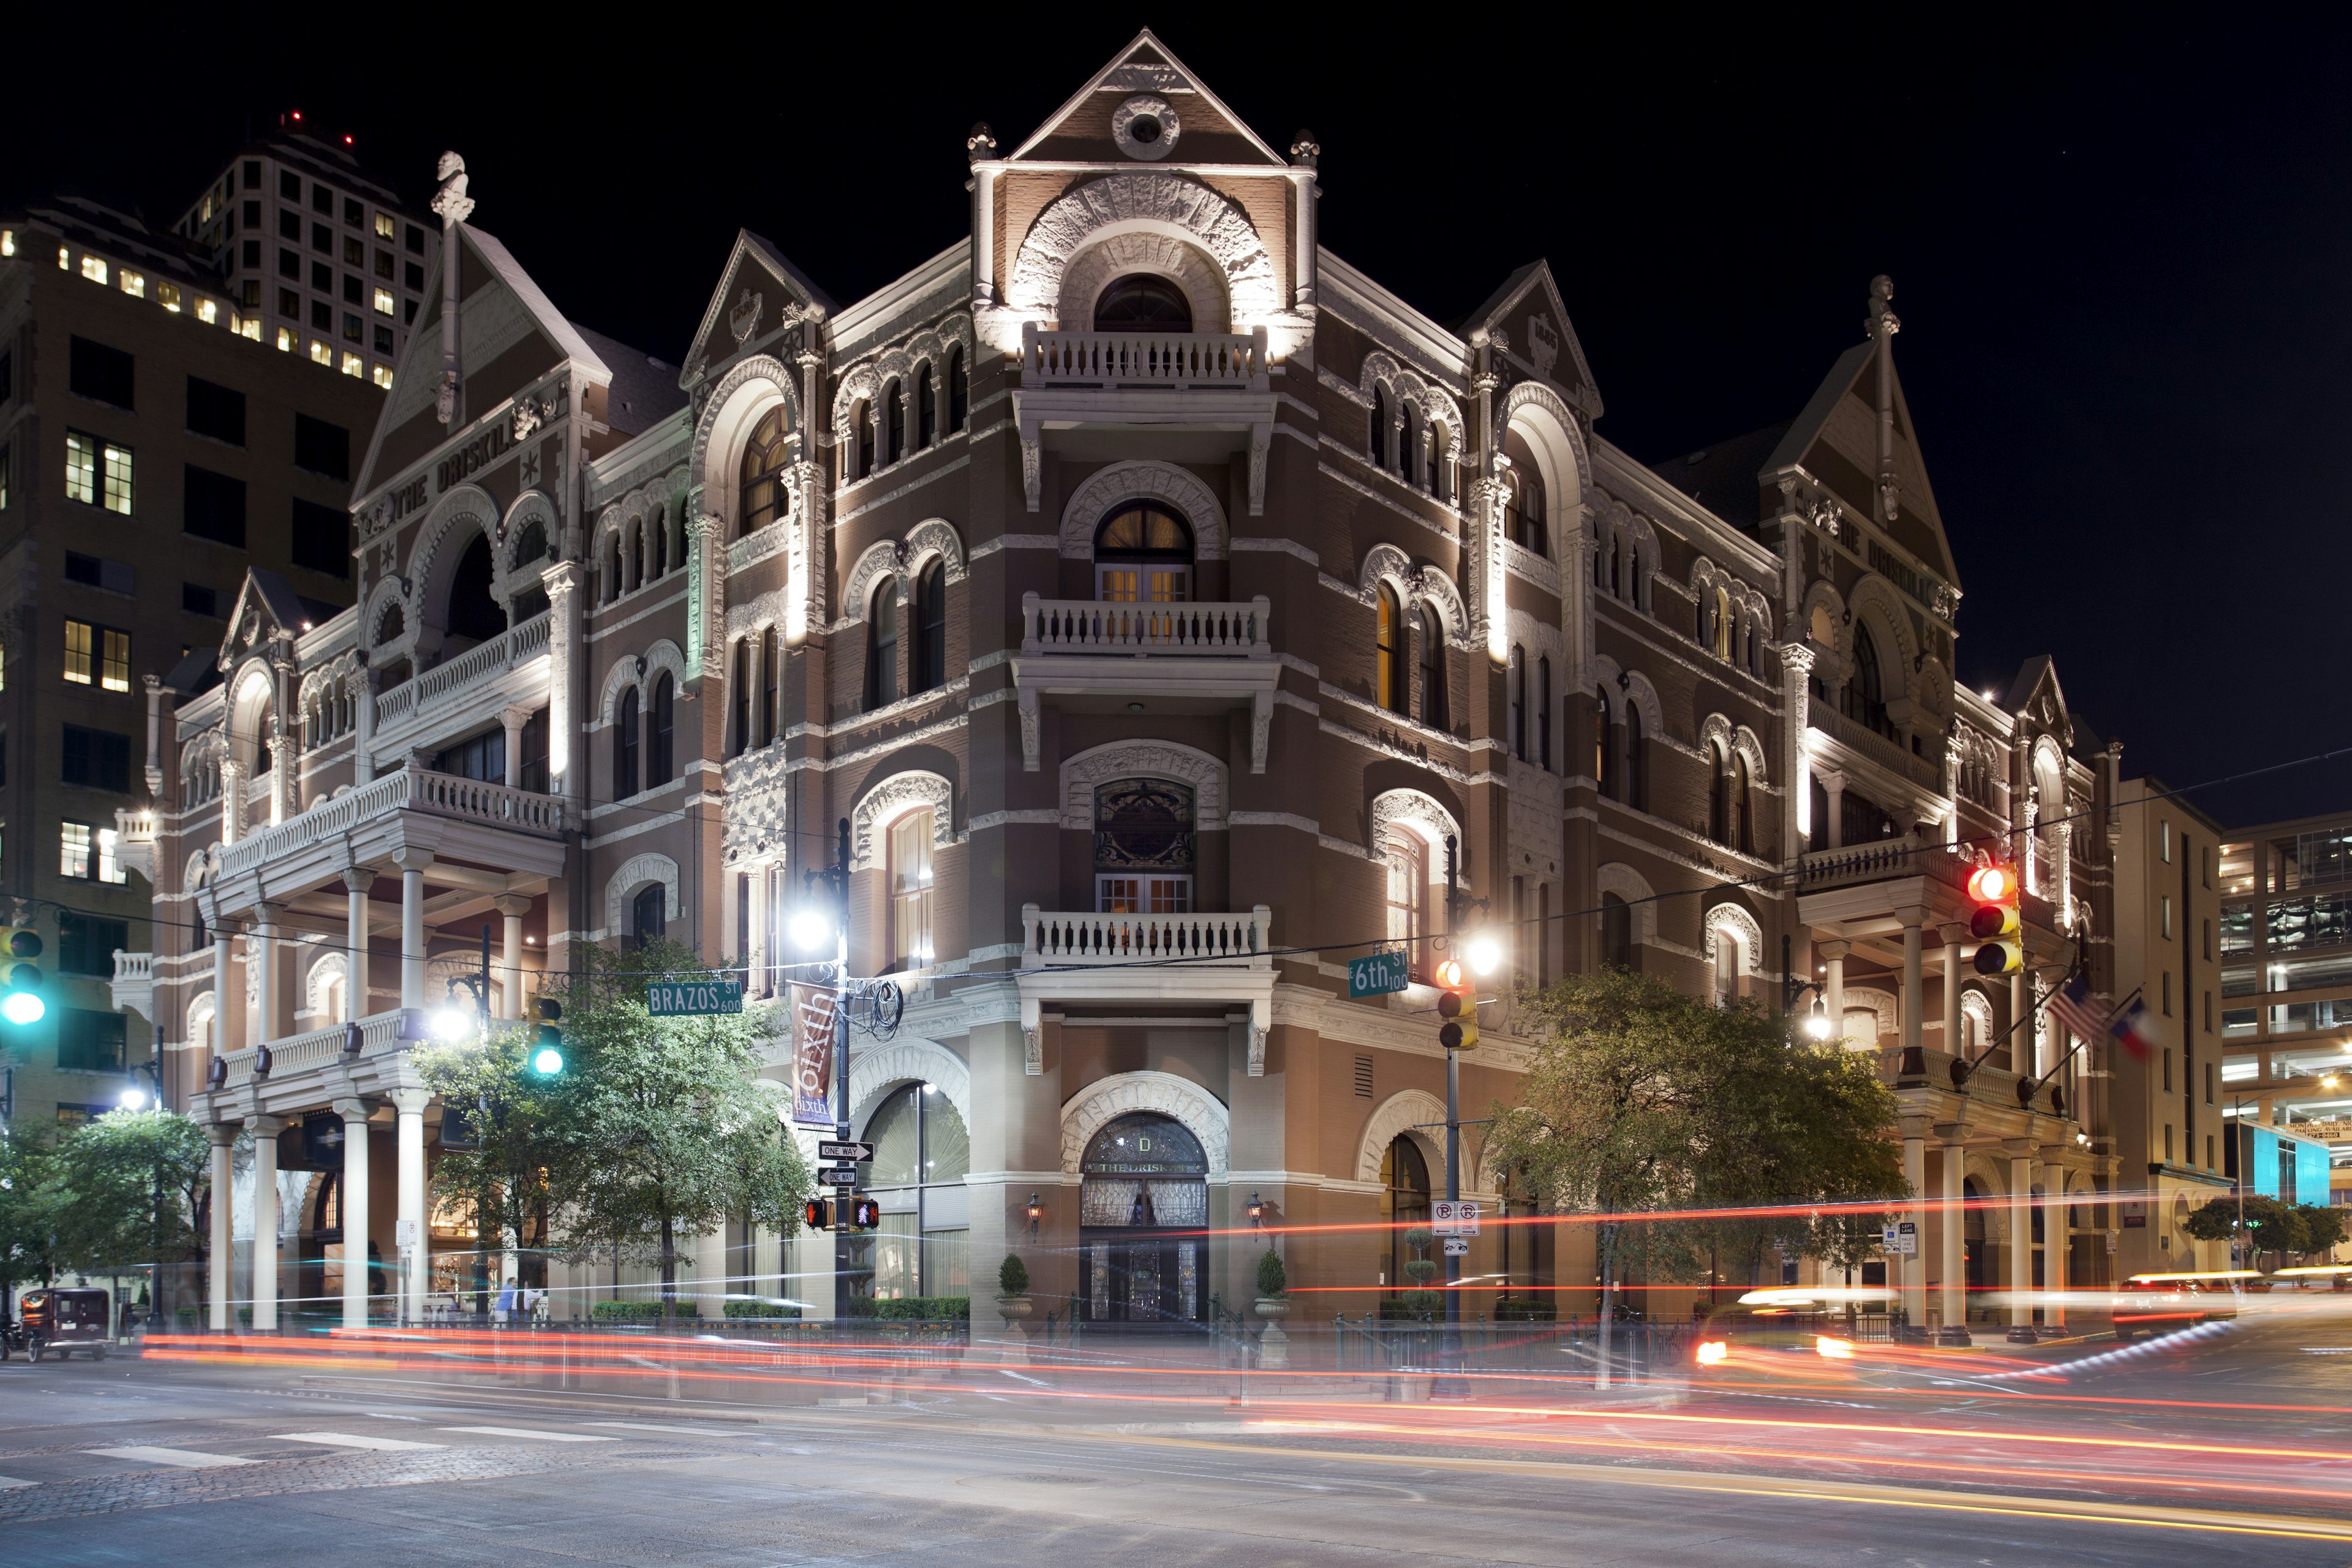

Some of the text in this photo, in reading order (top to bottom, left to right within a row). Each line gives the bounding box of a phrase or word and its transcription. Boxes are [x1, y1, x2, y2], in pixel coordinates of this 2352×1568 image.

[733, 298, 756, 324] 1885
[1535, 322, 1556, 350] 1885
[394, 416, 520, 519] THE DRISKILL
[1393, 951, 1406, 967] ST
[1355, 960, 1388, 990] 6th
[1389, 974, 1408, 990] 100
[725, 982, 737, 994] ST
[650, 987, 718, 1012] BRAZOS
[721, 1000, 741, 1012] 600
[842, 1147, 858, 1156] WAY
[1139, 1137, 1152, 1152] D
